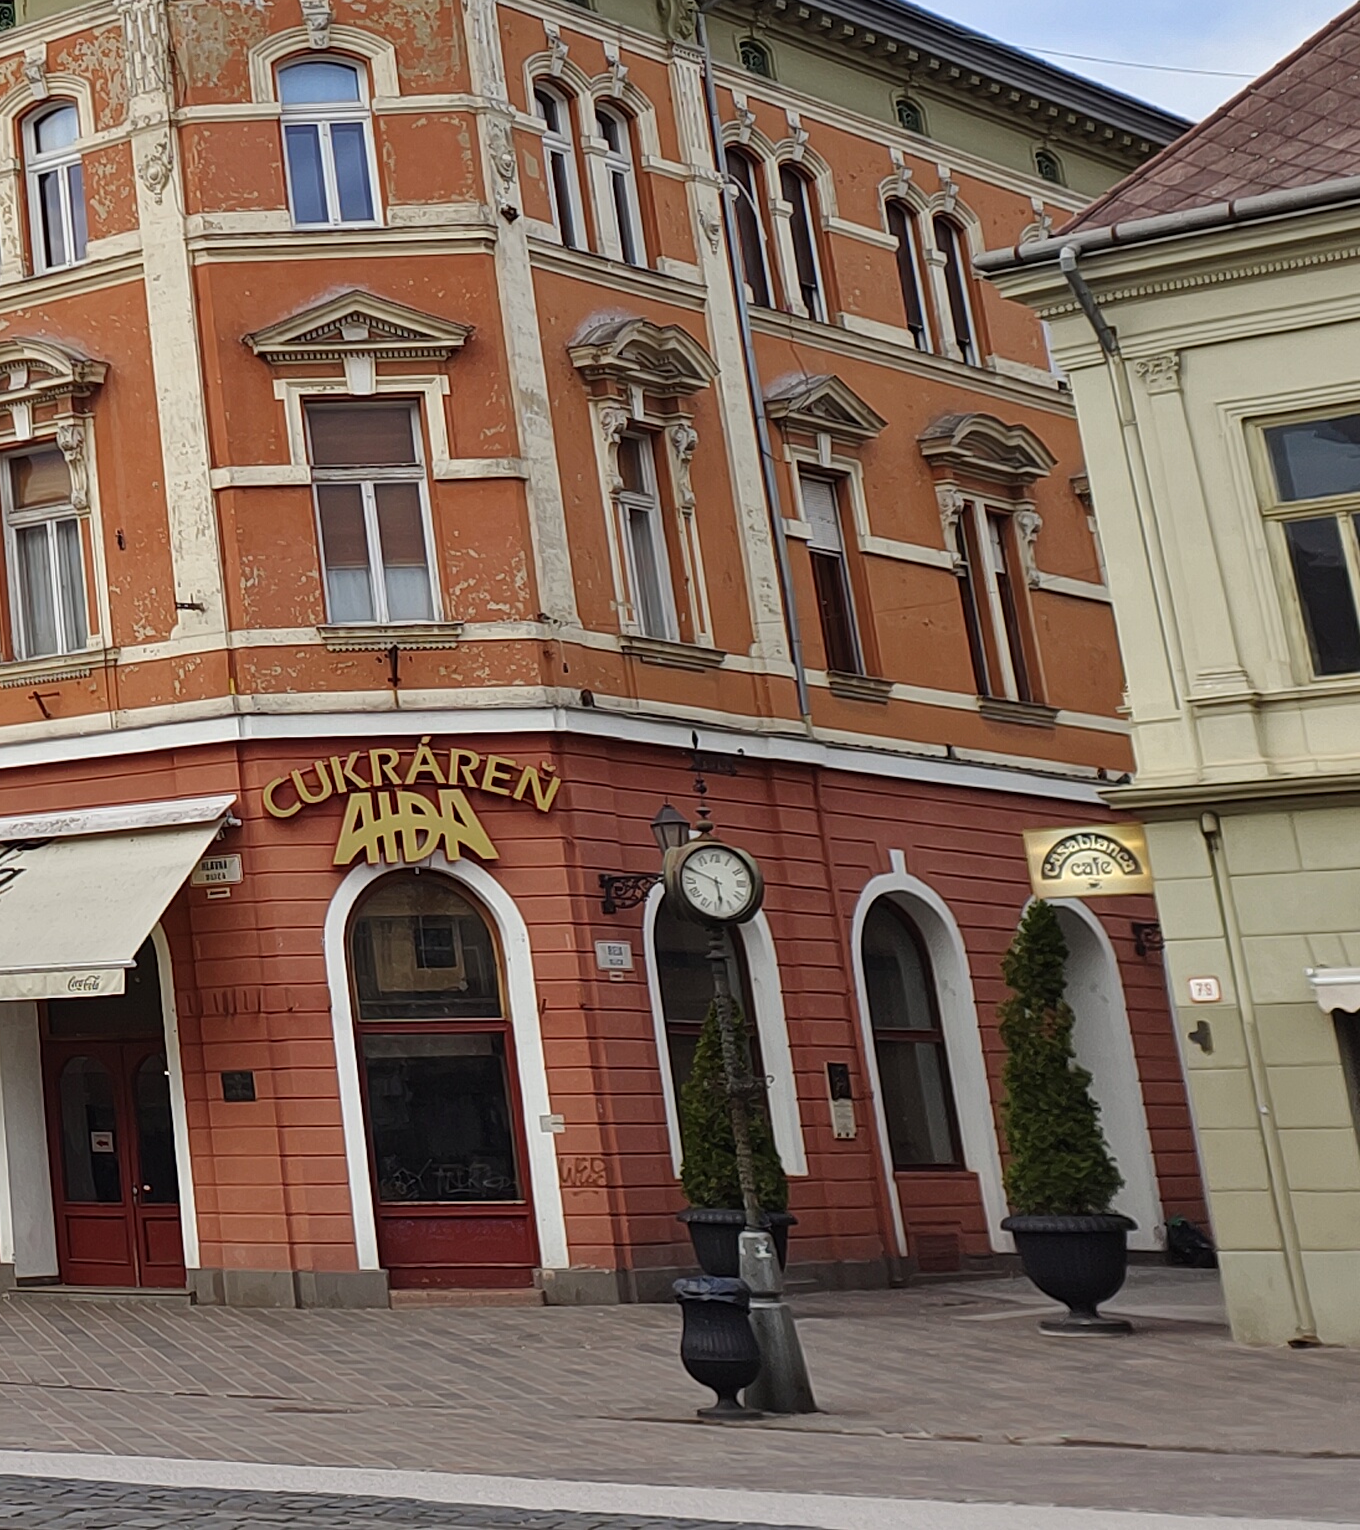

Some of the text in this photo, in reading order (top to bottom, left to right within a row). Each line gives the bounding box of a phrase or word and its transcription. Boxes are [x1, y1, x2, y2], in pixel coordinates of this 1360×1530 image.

[263, 736, 562, 818] CUKRÁREŇ
[333, 789, 500, 865] AIDA
[1043, 834, 1136, 876] Casablanca
